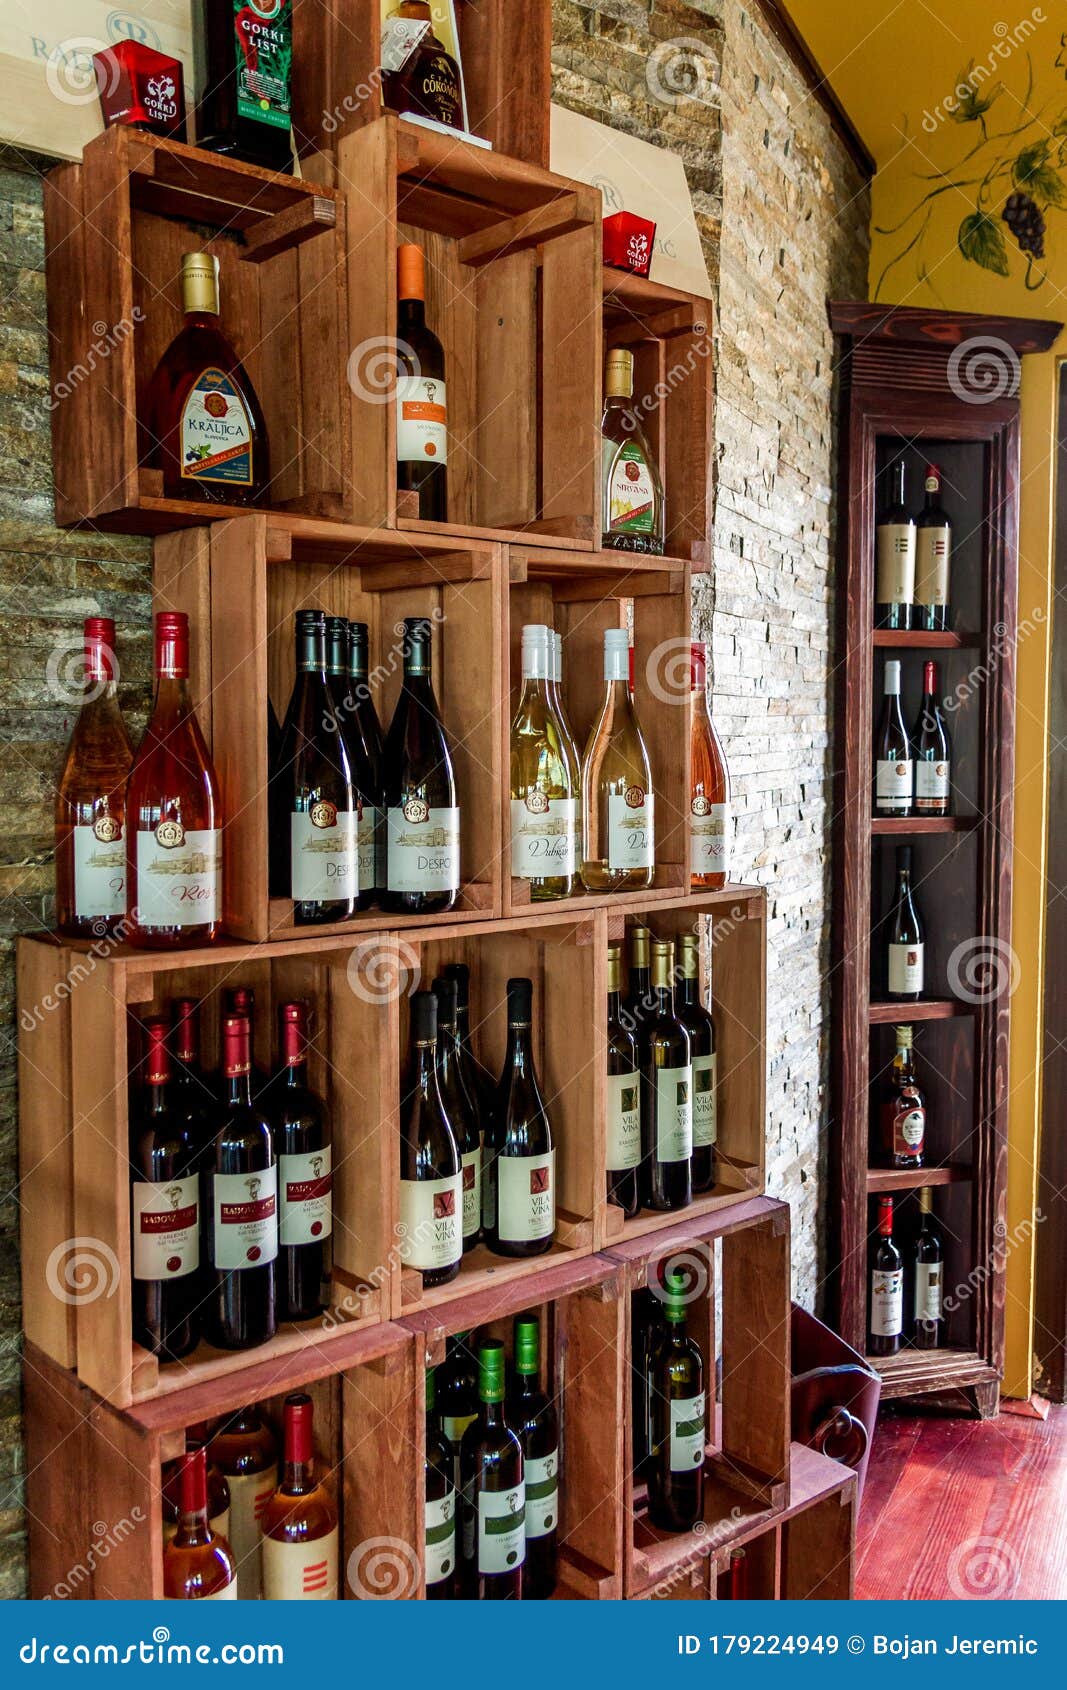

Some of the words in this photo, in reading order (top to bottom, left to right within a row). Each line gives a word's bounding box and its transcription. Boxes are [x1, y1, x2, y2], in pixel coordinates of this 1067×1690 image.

[241, 19, 284, 43] GORKI
[249, 36, 278, 54] LIST
[144, 97, 174, 115] GORKI
[149, 108, 170, 122] LIST
[441, 111, 453, 124] 12
[188, 419, 244, 437] KRALJICA
[531, 1195, 550, 1206] VILA
[531, 1205, 550, 1215] VINA
[434, 1221, 455, 1232] VILA
[434, 1231, 456, 1241] VINA
